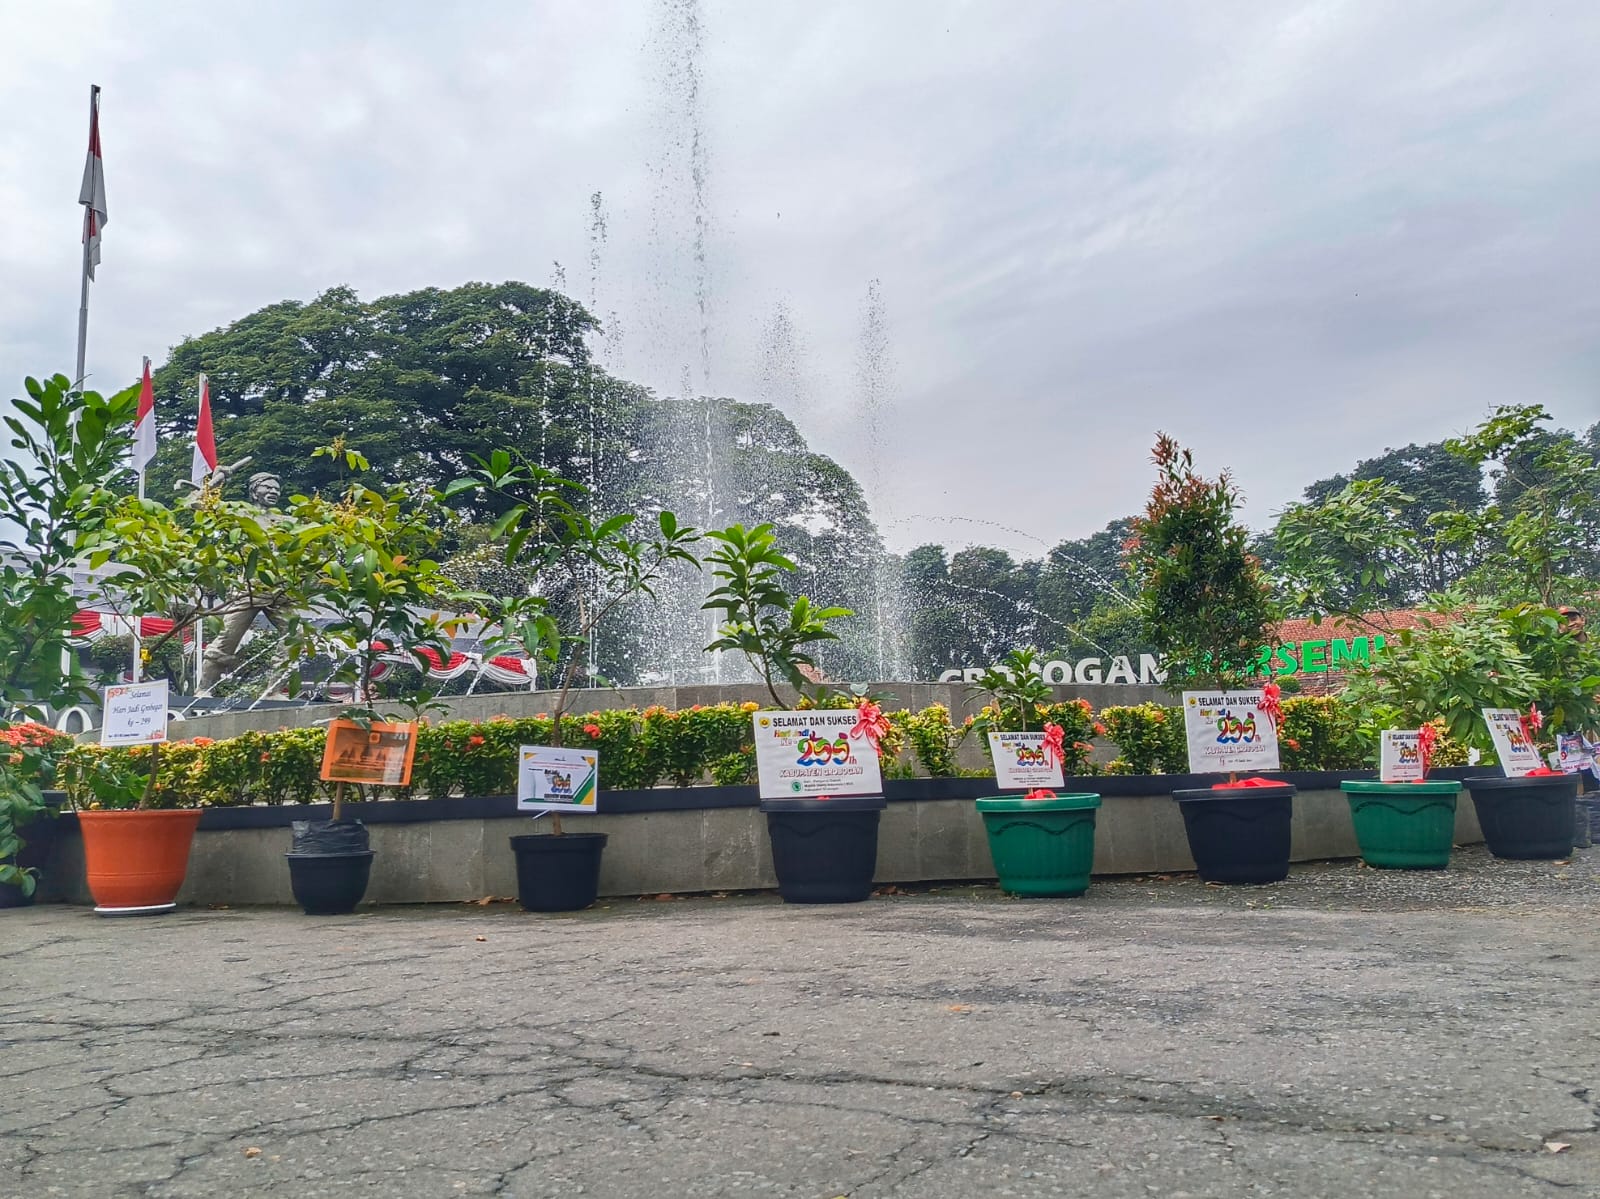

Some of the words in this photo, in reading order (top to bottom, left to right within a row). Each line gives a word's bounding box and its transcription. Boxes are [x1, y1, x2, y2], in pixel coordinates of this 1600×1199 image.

[1198, 697, 1225, 706] SELAMAT
[1226, 697, 1238, 705] DAN
[773, 717, 808, 727] SELAMAT
[809, 717, 825, 726] DAN
[827, 715, 857, 725] SUKSES
